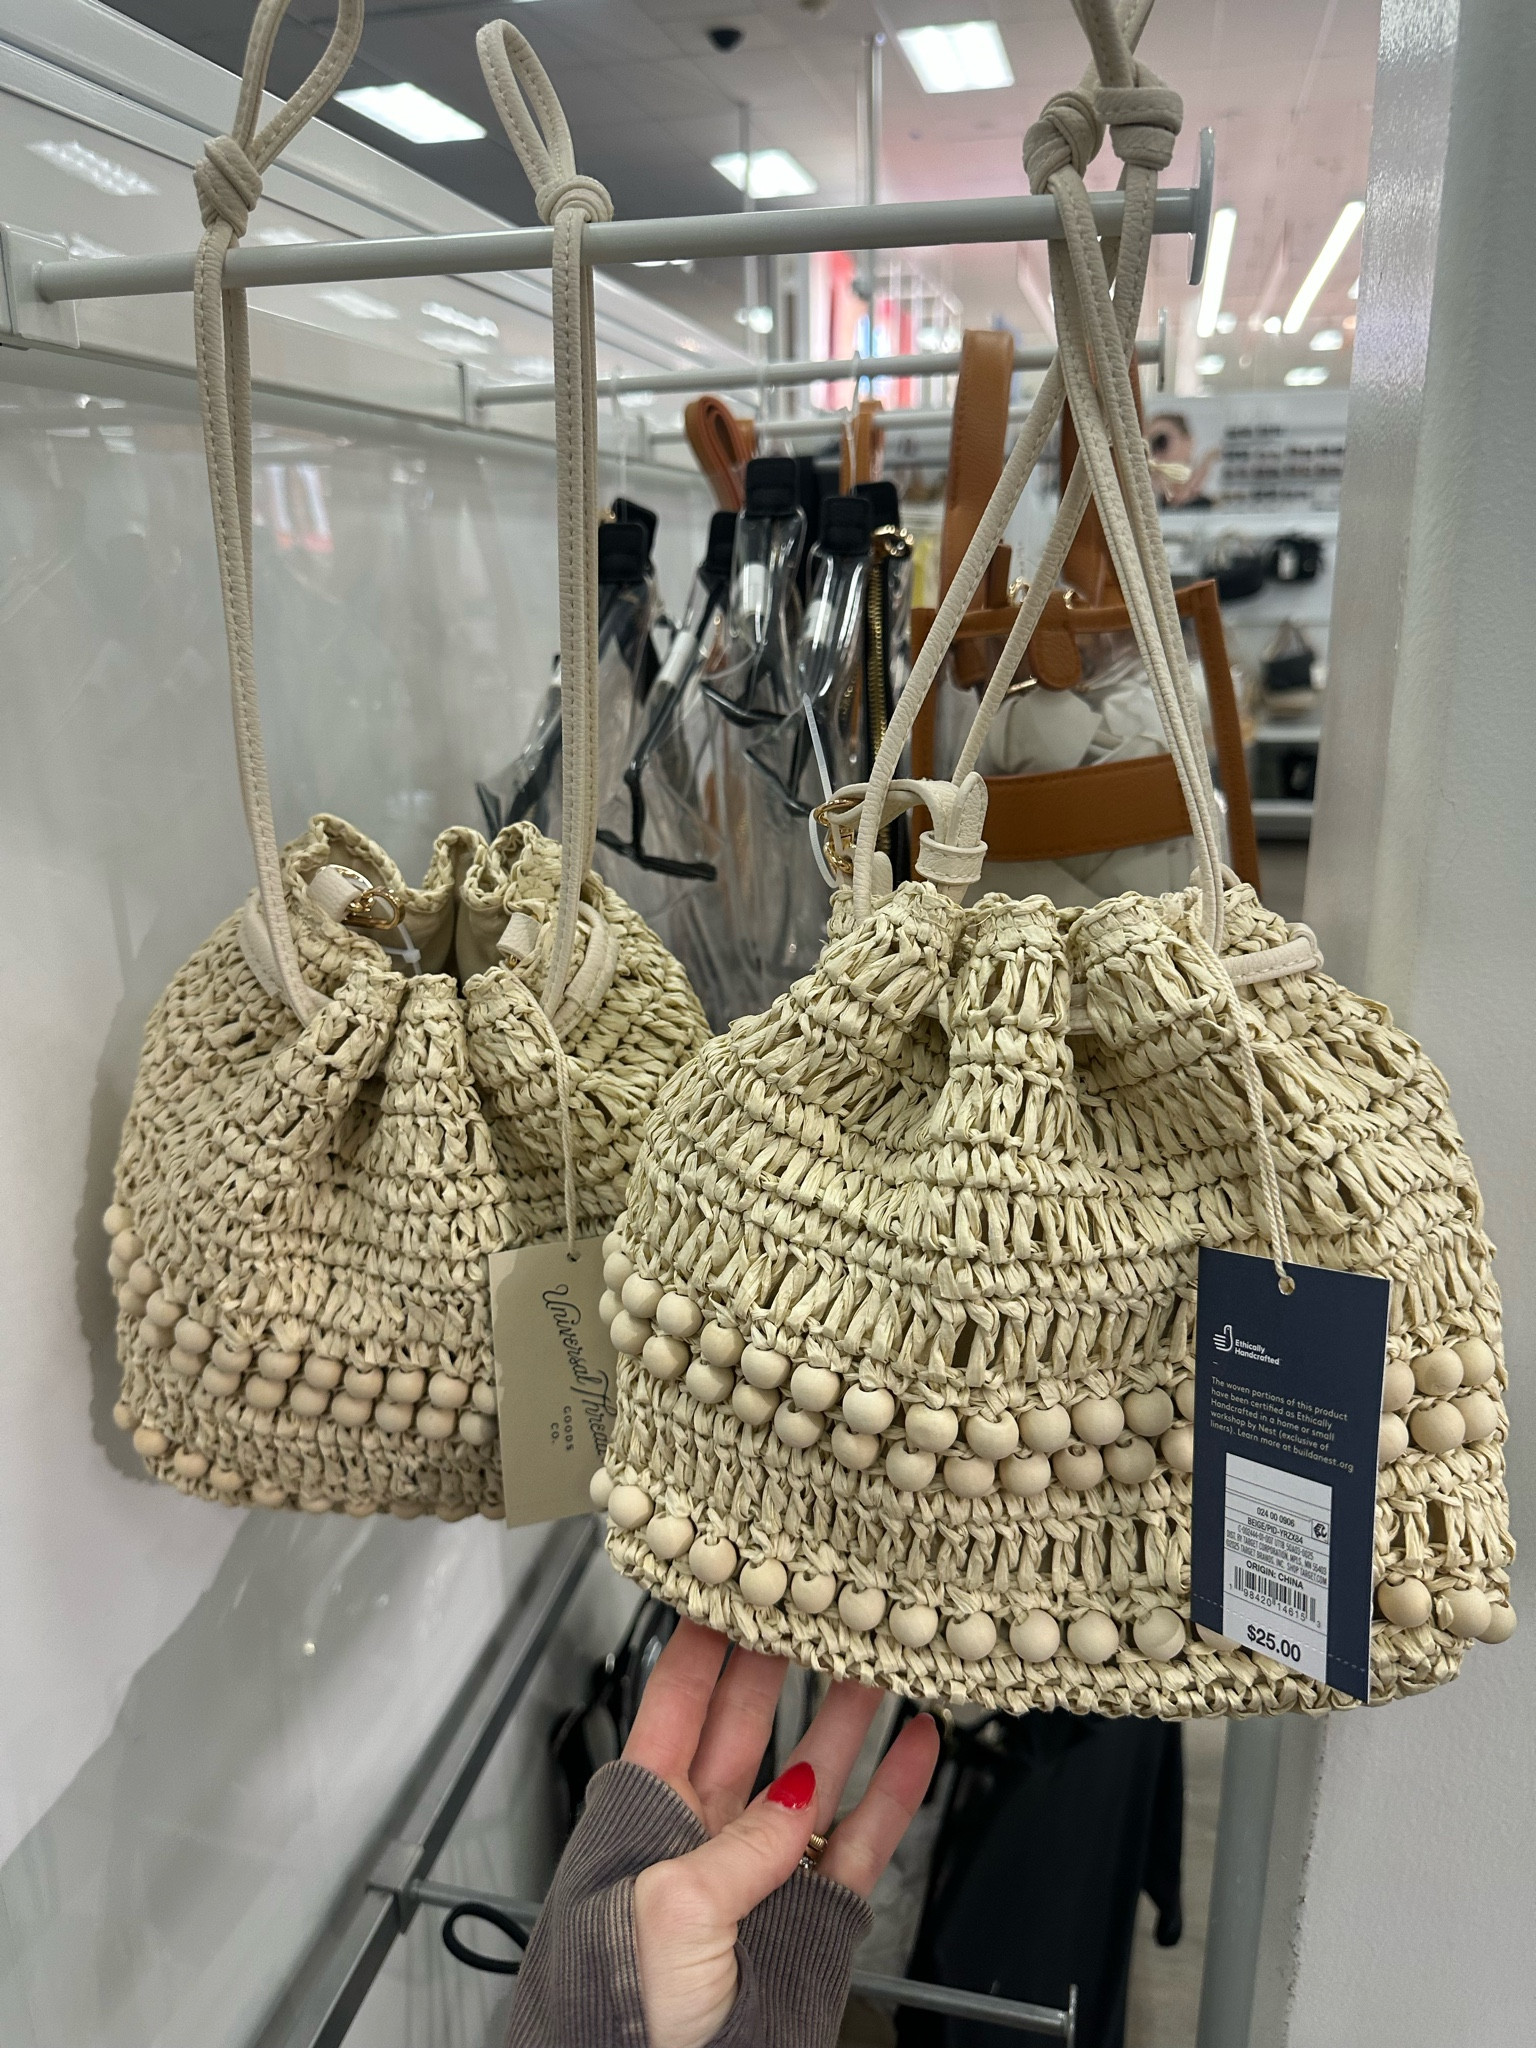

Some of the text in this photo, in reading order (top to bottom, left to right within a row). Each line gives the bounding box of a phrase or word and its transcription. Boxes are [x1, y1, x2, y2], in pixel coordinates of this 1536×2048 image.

[542, 1283, 601, 1385] Universal
[1235, 1339, 1266, 1354] Ethically
[1211, 1376, 1348, 1421] The woven portions of this product
[1211, 1388, 1332, 1431] have been certified as Ethically
[563, 1405, 574, 1451] GOODS
[1210, 1398, 1258, 1419] Handcrafted
[1260, 1412, 1268, 1422] in
[1276, 1418, 1299, 1431] home
[1312, 1429, 1335, 1441] small
[1210, 1408, 1330, 1452] workshop by Nest (exclusive of
[1210, 1420, 1354, 1474] liners). Learn more at buildanest.org
[1256, 1507, 1295, 1527] 024 00 0906
[1240, 1543, 1256, 1556] TARGET
[1243, 1535, 1258, 1547] TARGET
[1246, 1560, 1304, 1589] ORIGIN: CHINA
[1243, 1588, 1272, 1607] 98420
[1277, 1603, 1306, 1622] 14615
[1247, 1624, 1301, 1662] $25.00
